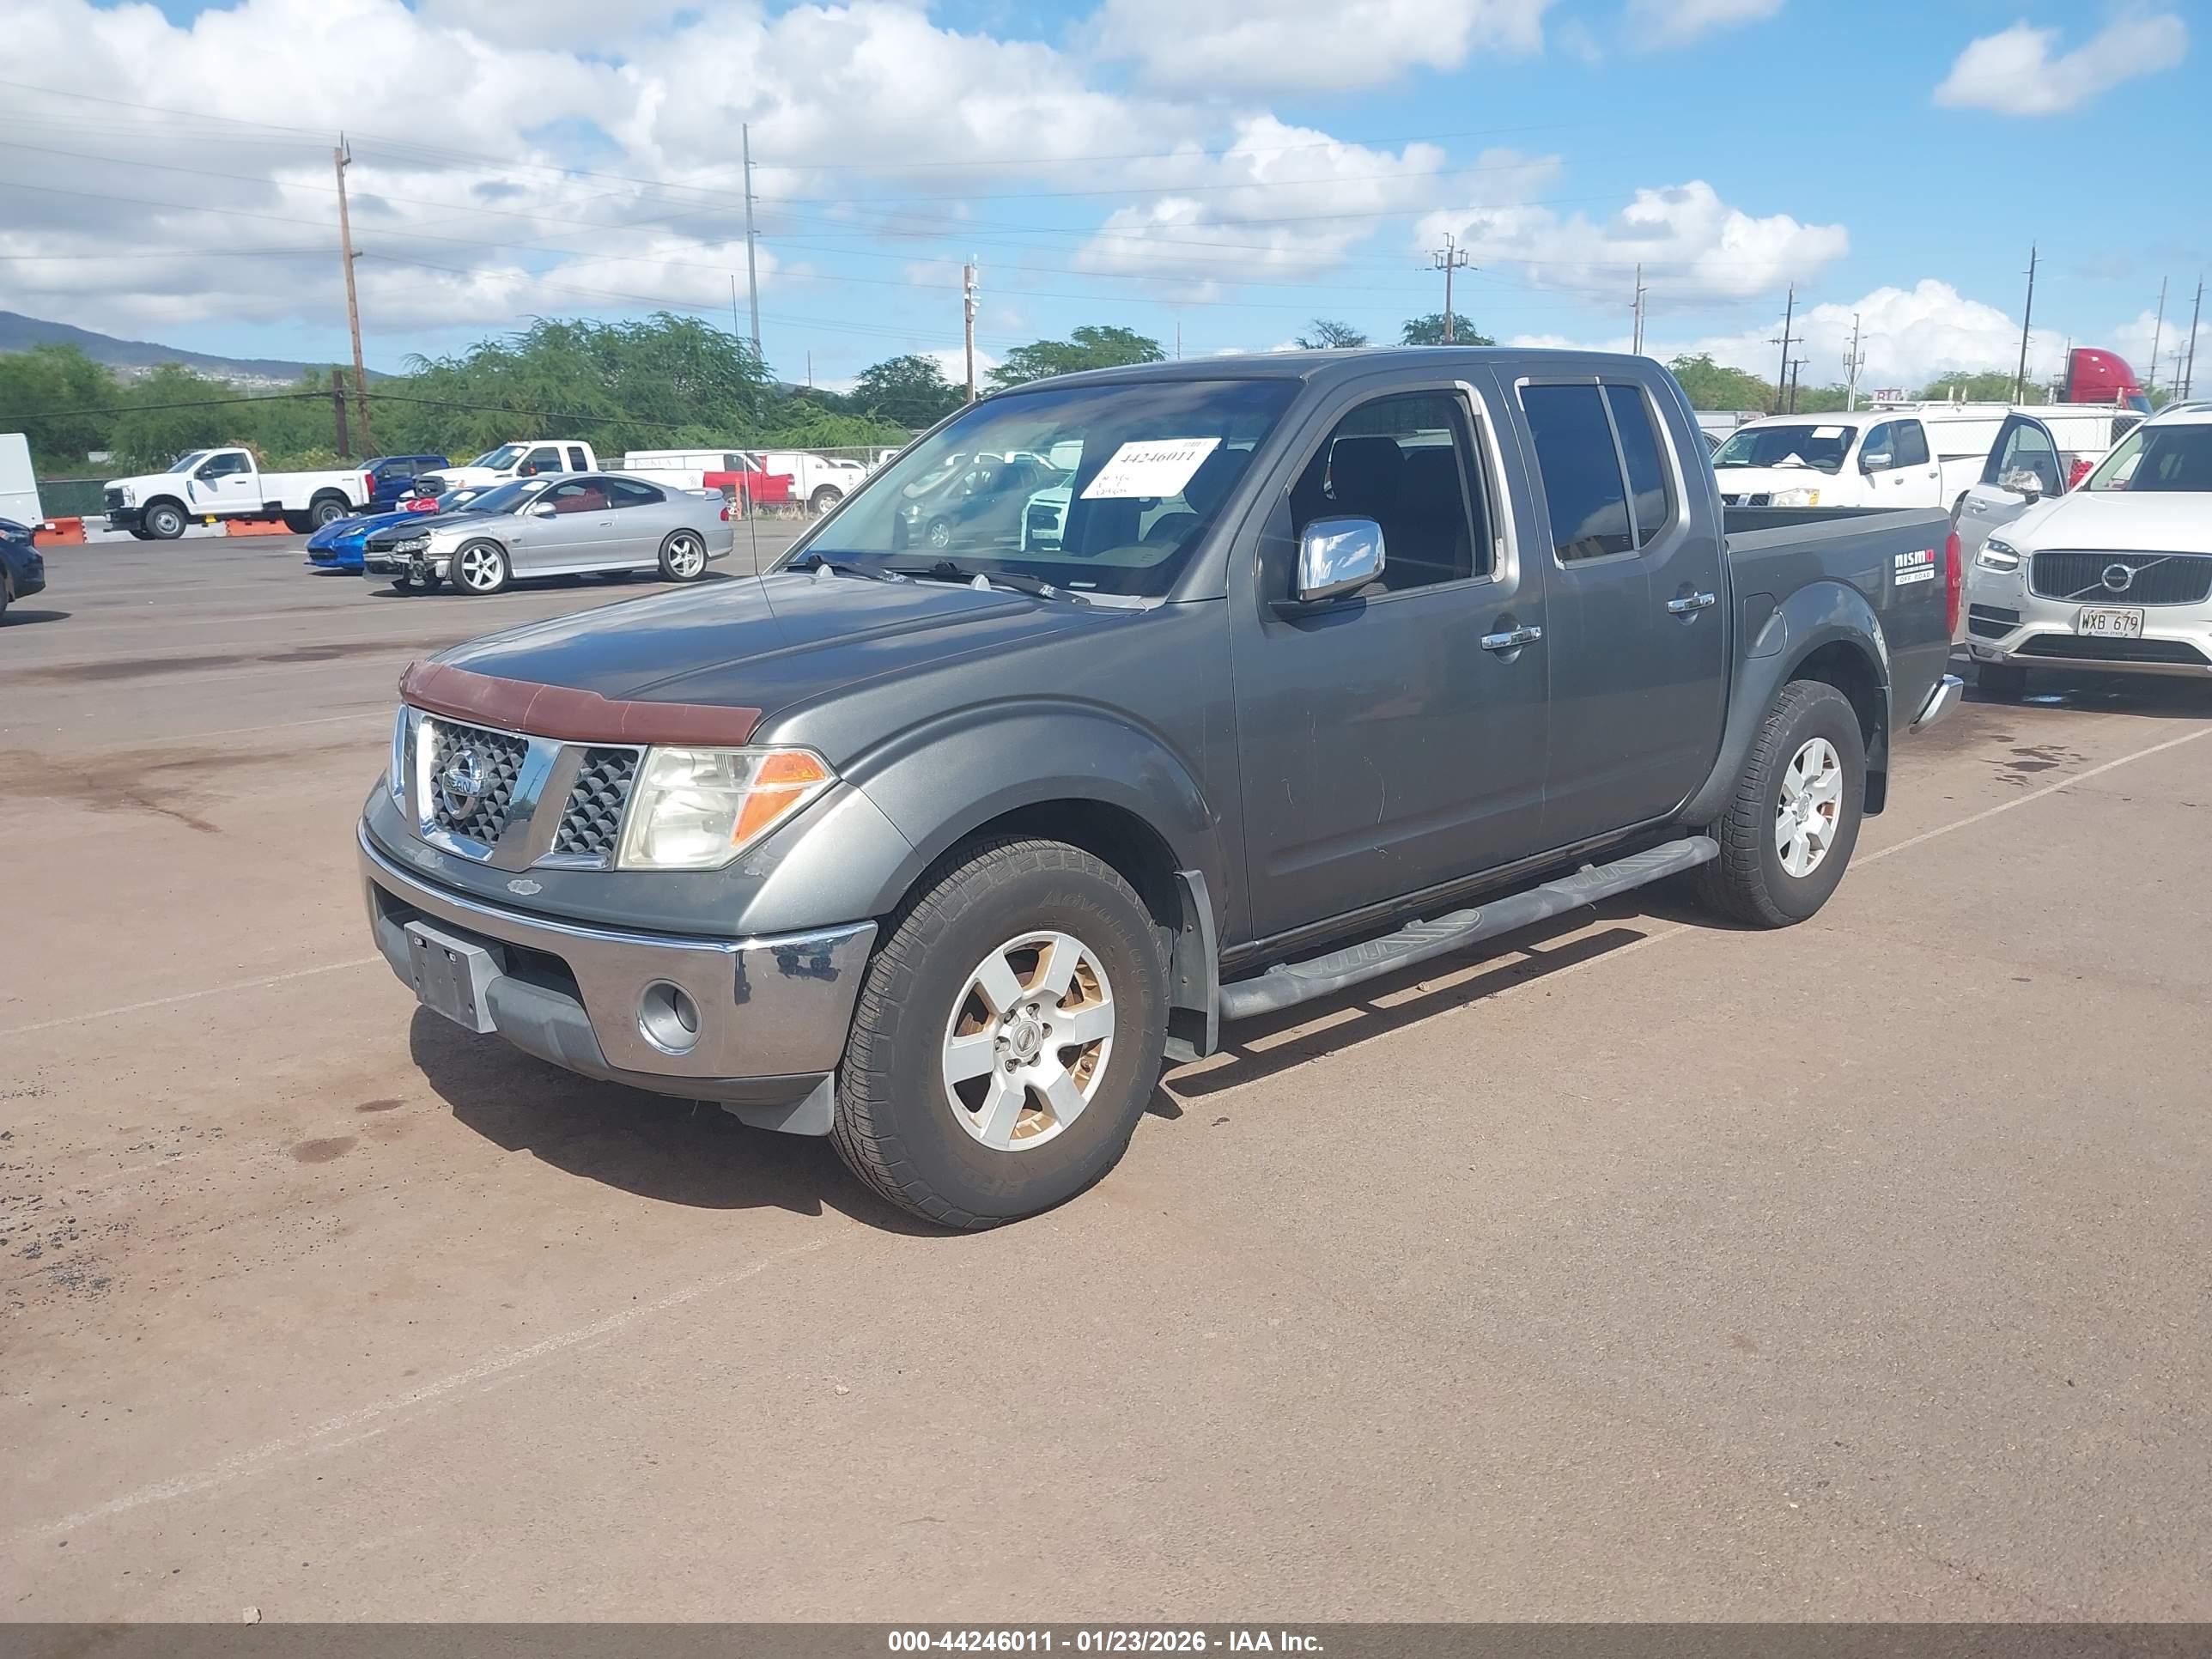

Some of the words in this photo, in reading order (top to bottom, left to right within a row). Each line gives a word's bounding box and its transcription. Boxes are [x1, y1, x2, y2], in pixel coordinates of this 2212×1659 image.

[1121, 451, 1196, 463] 44246011
[2081, 614, 2106, 630] WXB
[2114, 616, 2138, 631] 679
